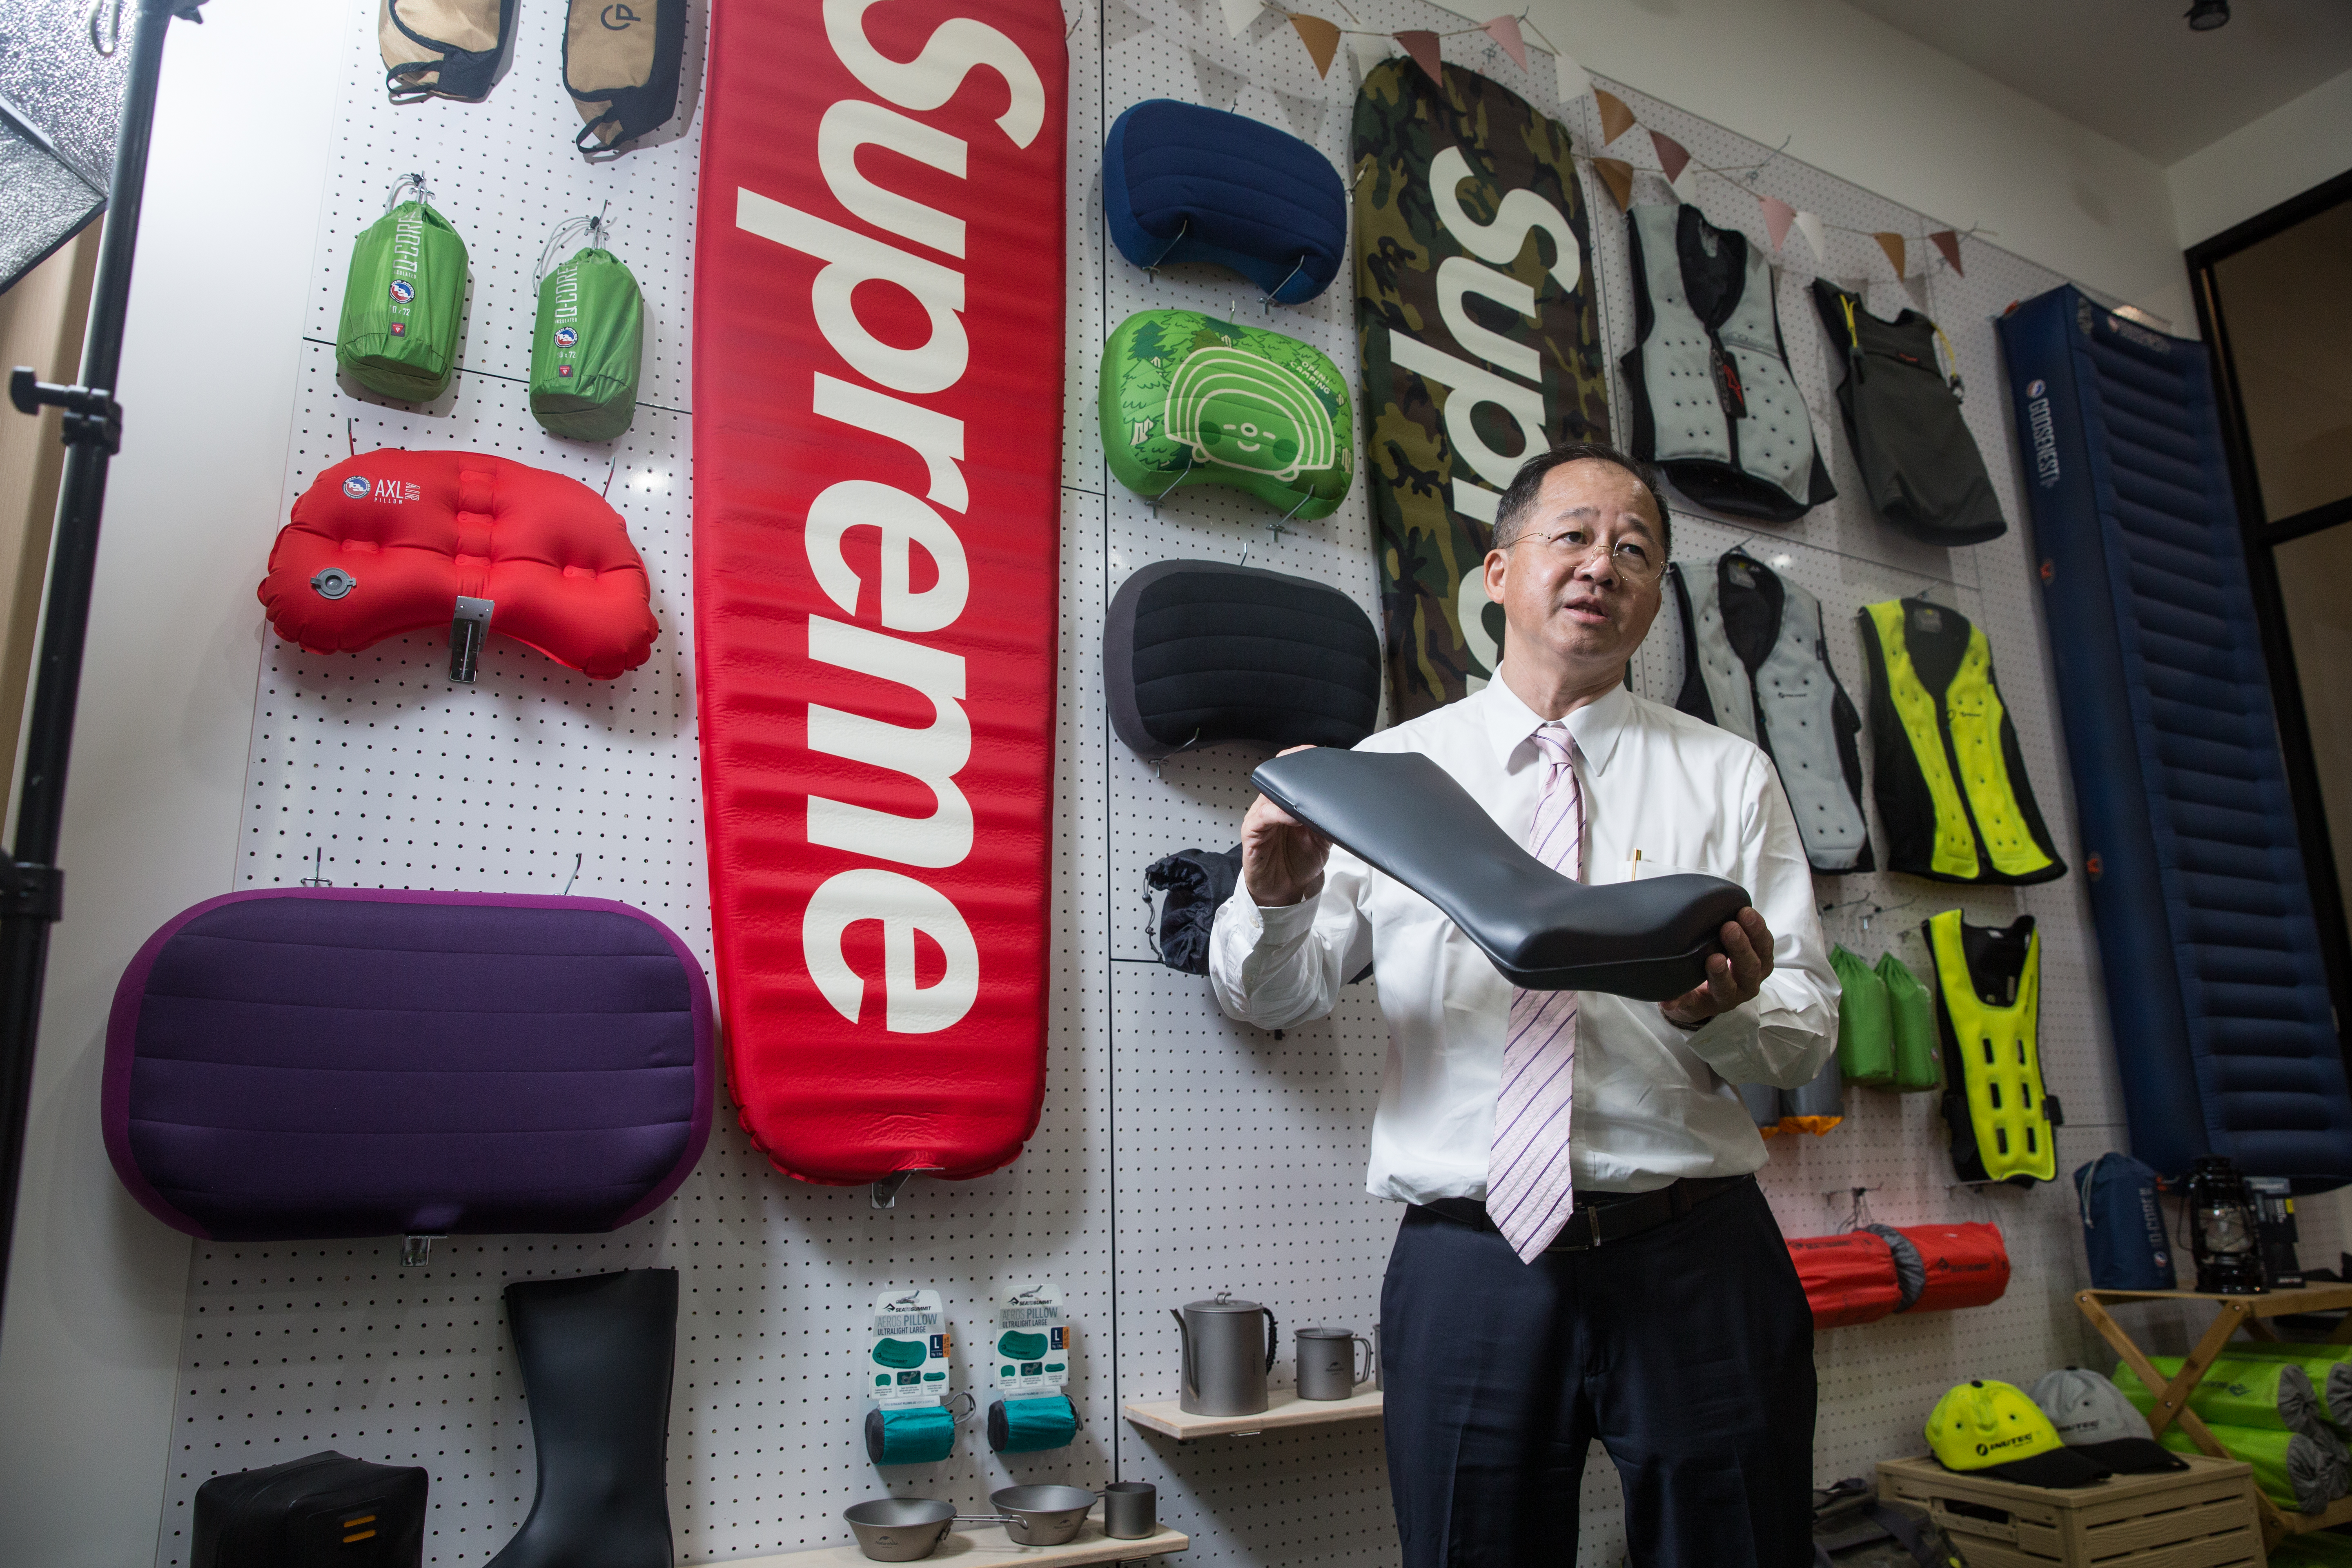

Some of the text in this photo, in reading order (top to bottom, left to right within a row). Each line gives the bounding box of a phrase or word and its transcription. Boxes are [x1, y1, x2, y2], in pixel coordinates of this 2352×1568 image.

[1290, 361, 1331, 394] CAMPING
[357, 476, 371, 492] AGNES
[374, 479, 404, 499] AXL
[404, 482, 421, 501] AIR
[736, 0, 1045, 1034] Supreme
[878, 1313, 938, 1327] AEROS PILLOW
[1002, 1307, 1058, 1321] AEROS PILLOW
[1002, 1320, 1031, 1328] ULTRALIGHT
[878, 1327, 908, 1336] ULTRALIGHT
[1055, 1329, 1060, 1341] L
[934, 1336, 940, 1349] L
